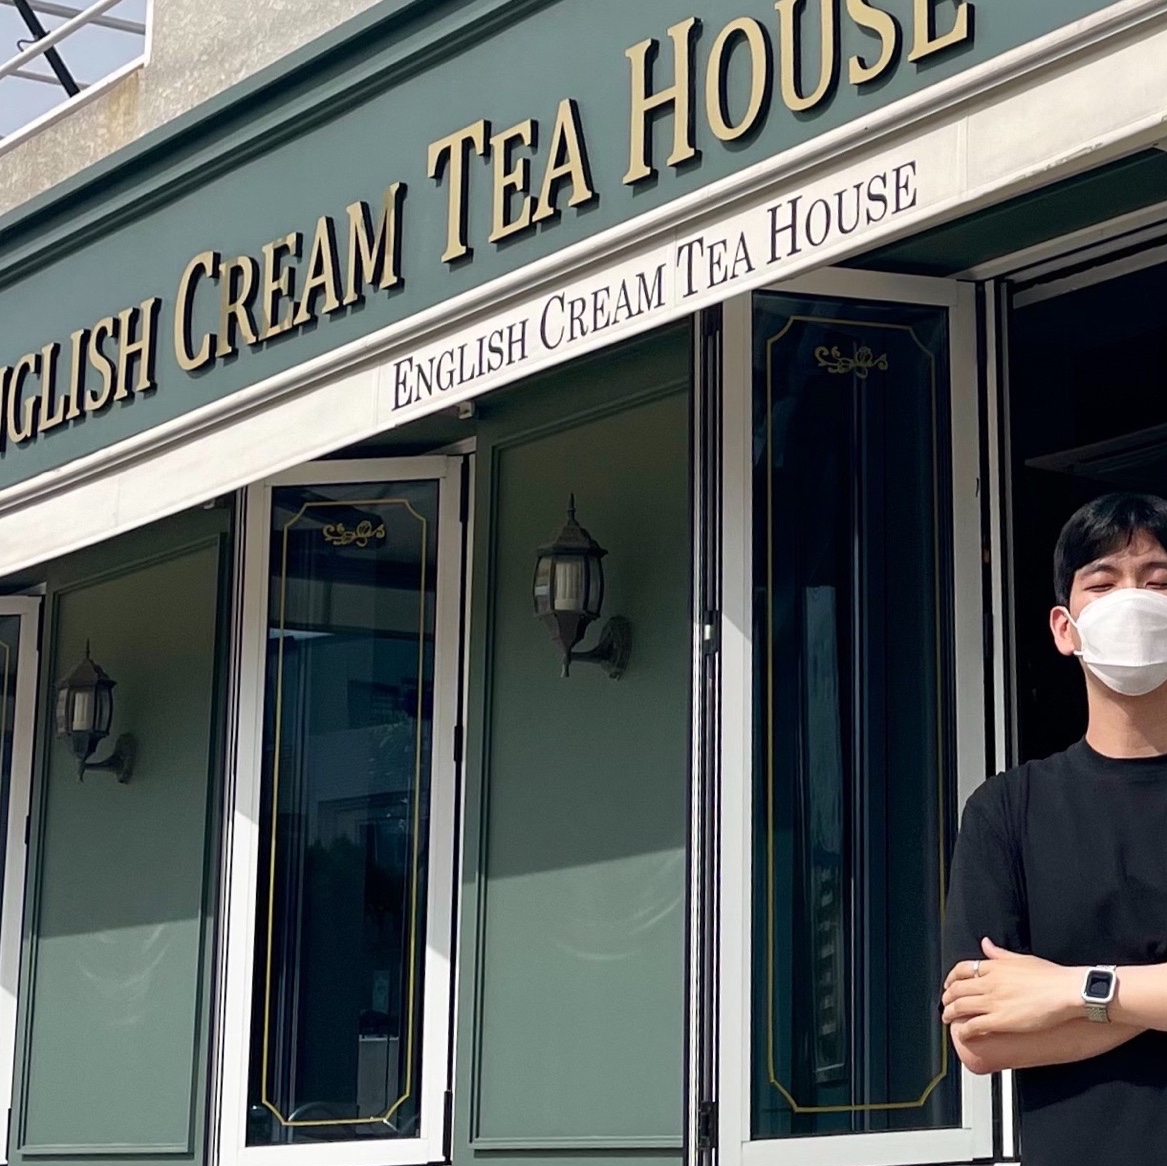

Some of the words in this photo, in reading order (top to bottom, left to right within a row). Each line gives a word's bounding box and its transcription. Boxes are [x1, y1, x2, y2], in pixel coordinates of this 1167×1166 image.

[0, 298, 162, 450] GLISH
[174, 182, 407, 372] CREAM
[427, 98, 599, 264] TEA
[392, 319, 530, 411] ENGLISH
[540, 262, 667, 352] CREAM
[677, 230, 756, 299] TEA
[766, 160, 918, 265] HOUSE
